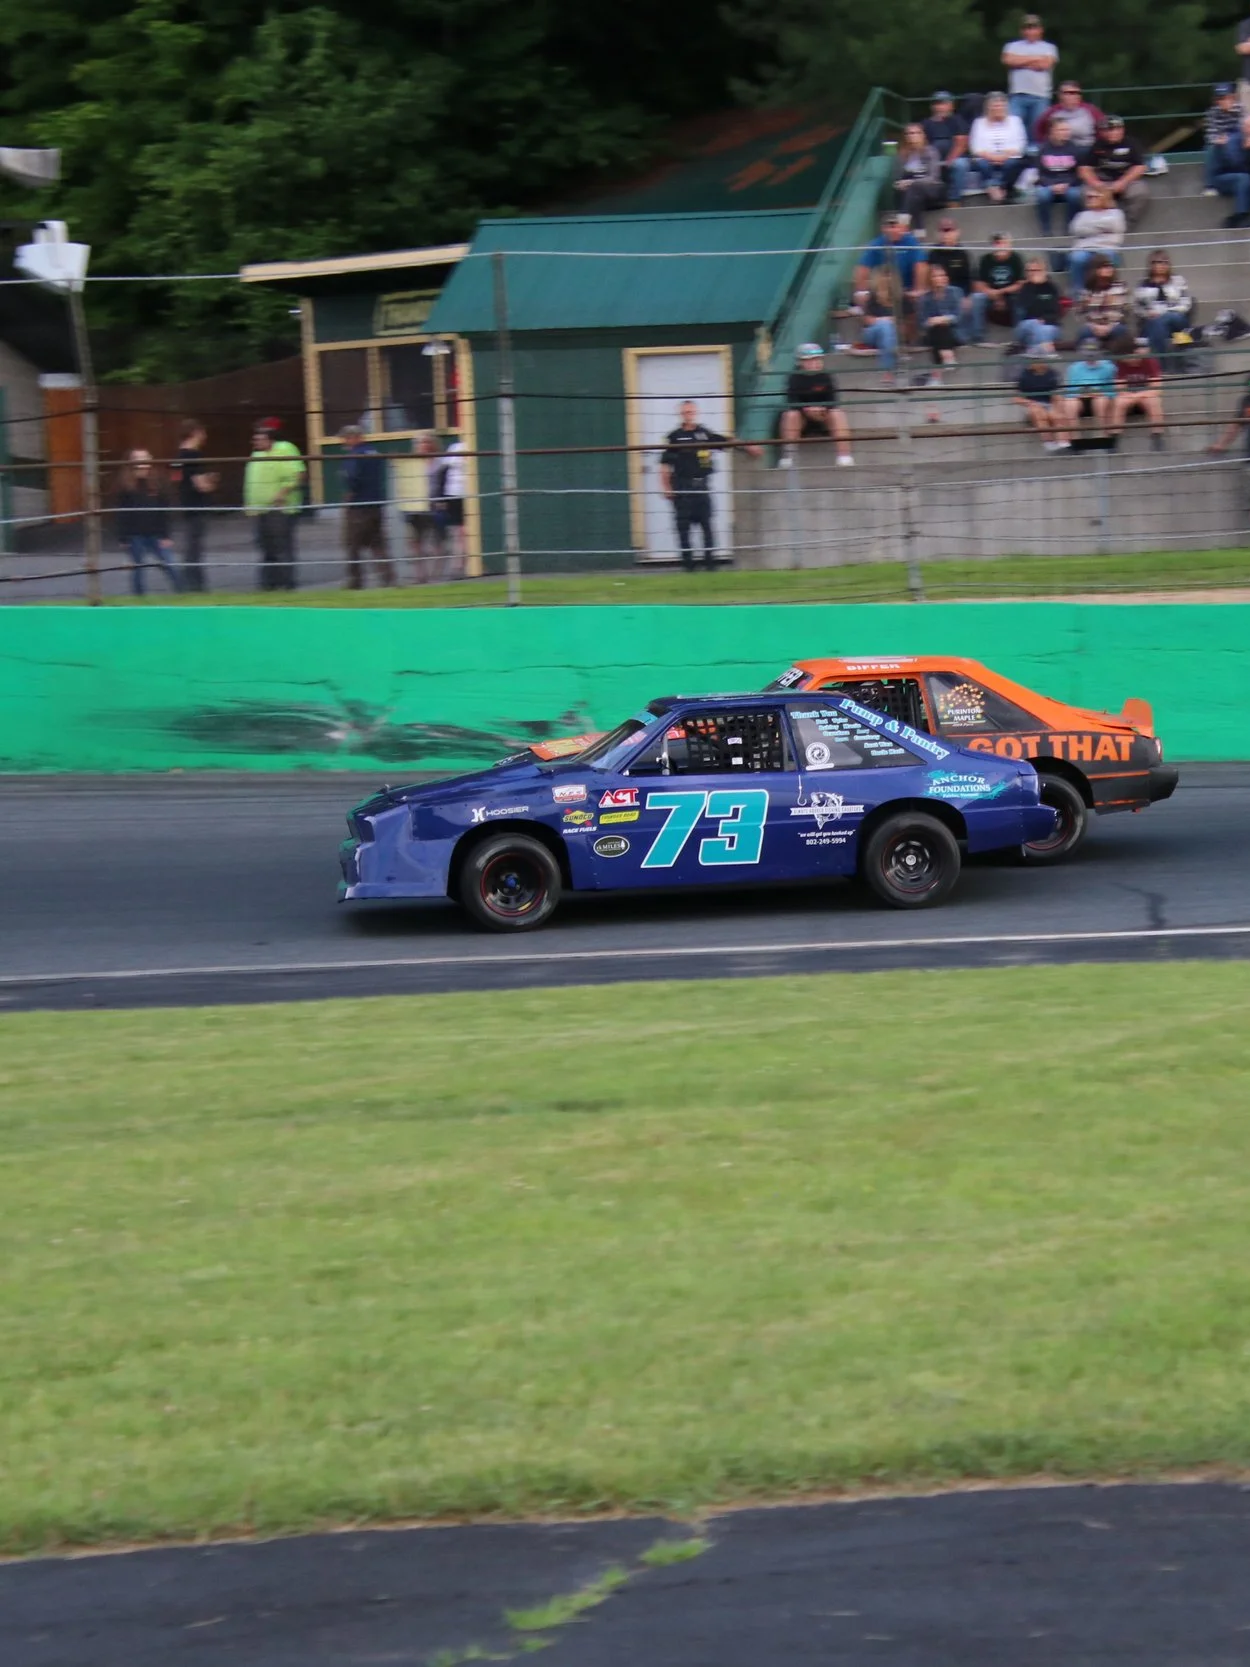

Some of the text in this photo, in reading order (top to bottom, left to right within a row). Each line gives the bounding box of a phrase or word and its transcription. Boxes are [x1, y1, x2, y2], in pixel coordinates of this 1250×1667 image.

[846, 663, 900, 671] DIFFER
[790, 709, 838, 720] Thank You
[839, 698, 951, 760] Pump & Pantry
[968, 735, 1135, 762] GOT THAT
[932, 775, 986, 786] ANCHOR
[929, 784, 991, 793] FOUNDATIONS
[600, 788, 639, 806] ACT
[486, 806, 530, 817] HOOSIER
[563, 812, 594, 823] SUNOCO
[579, 826, 597, 834] FUELS
[640, 789, 769, 868] 73
[805, 837, 846, 845] 802-249-5994
